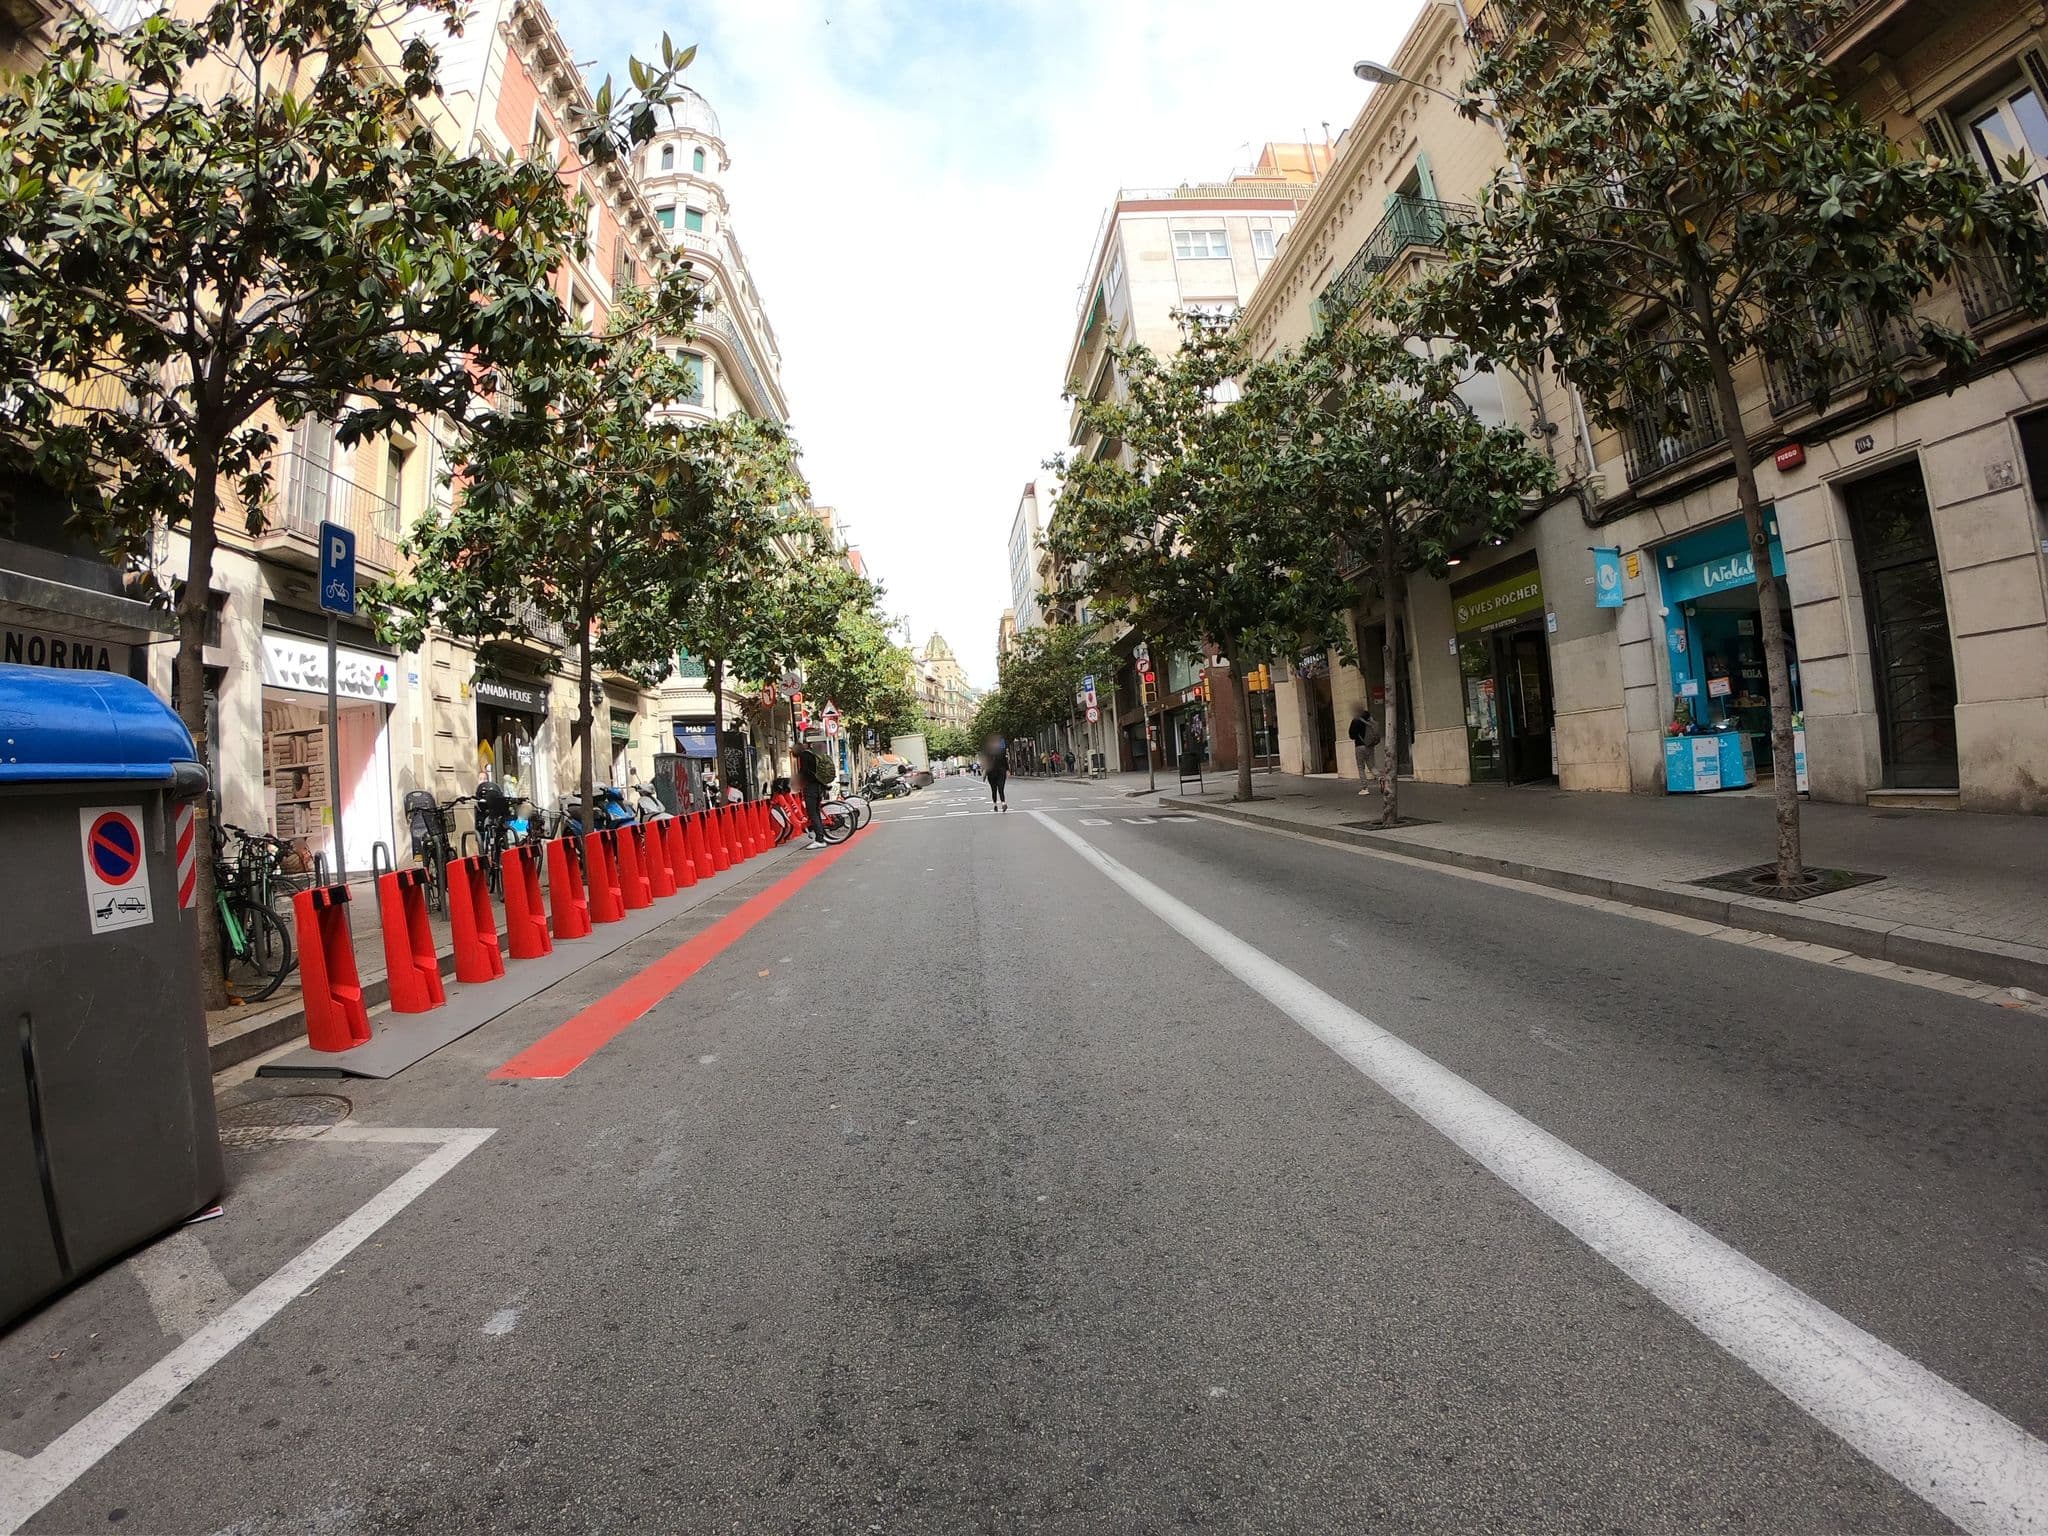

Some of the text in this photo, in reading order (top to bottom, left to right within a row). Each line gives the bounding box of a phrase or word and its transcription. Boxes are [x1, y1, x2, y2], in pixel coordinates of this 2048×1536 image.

[1856, 438, 1872, 451] 104
[331, 536, 346, 568] P
[1469, 584, 1538, 616] YVES ROCHER
[5, 631, 111, 672] NORMA
[476, 682, 532, 703] CANADA HOUSE
